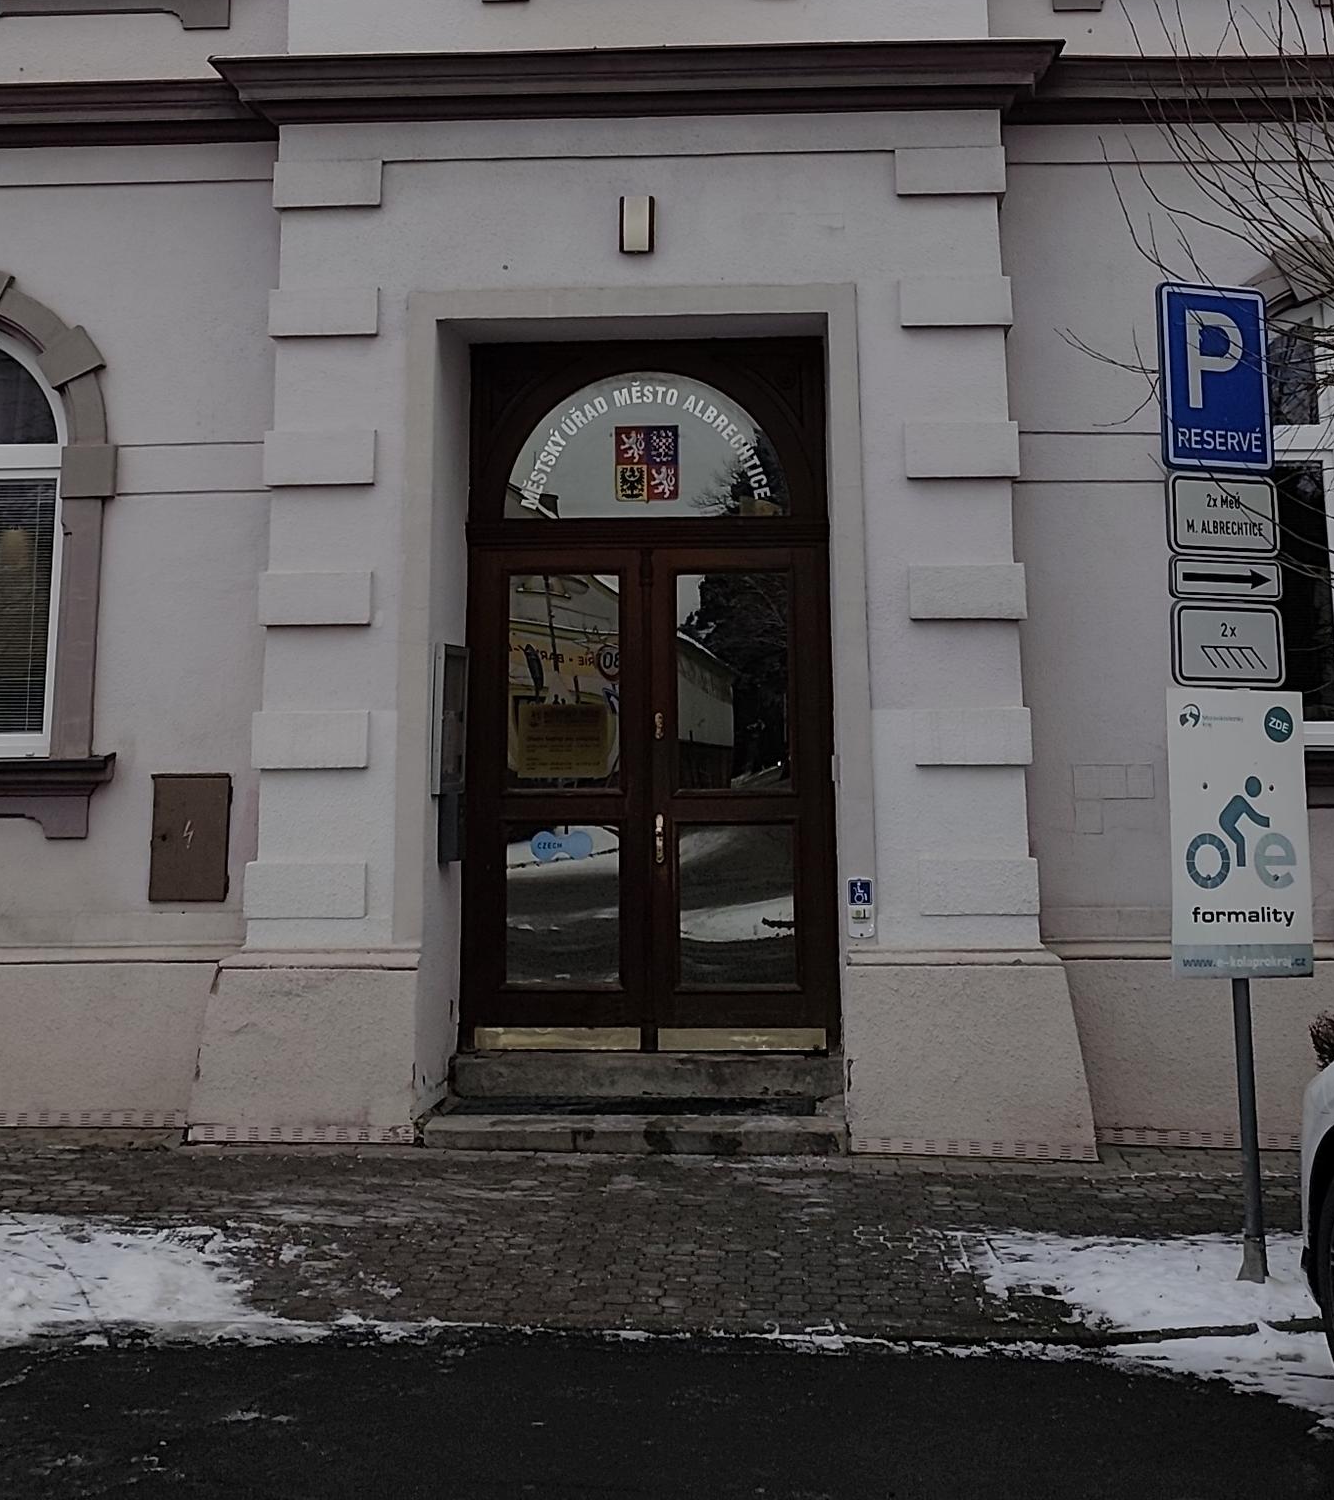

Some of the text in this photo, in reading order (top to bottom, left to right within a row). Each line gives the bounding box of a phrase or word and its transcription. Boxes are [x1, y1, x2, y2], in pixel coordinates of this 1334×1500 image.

[1186, 309, 1244, 409] P
[520, 381, 771, 511] MĚSTSKÝ ÚŘAD MĚSTO ALBRECHTICE
[1177, 428, 1262, 452] RESERVÉ
[1206, 494, 1217, 508] 2x
[1187, 519, 1263, 537] M. ALBRECHTICE
[1220, 623, 1237, 637] 2x
[1268, 717, 1290, 734] ZDE
[537, 841, 563, 850] CZECH
[1191, 906, 1296, 927] formality
